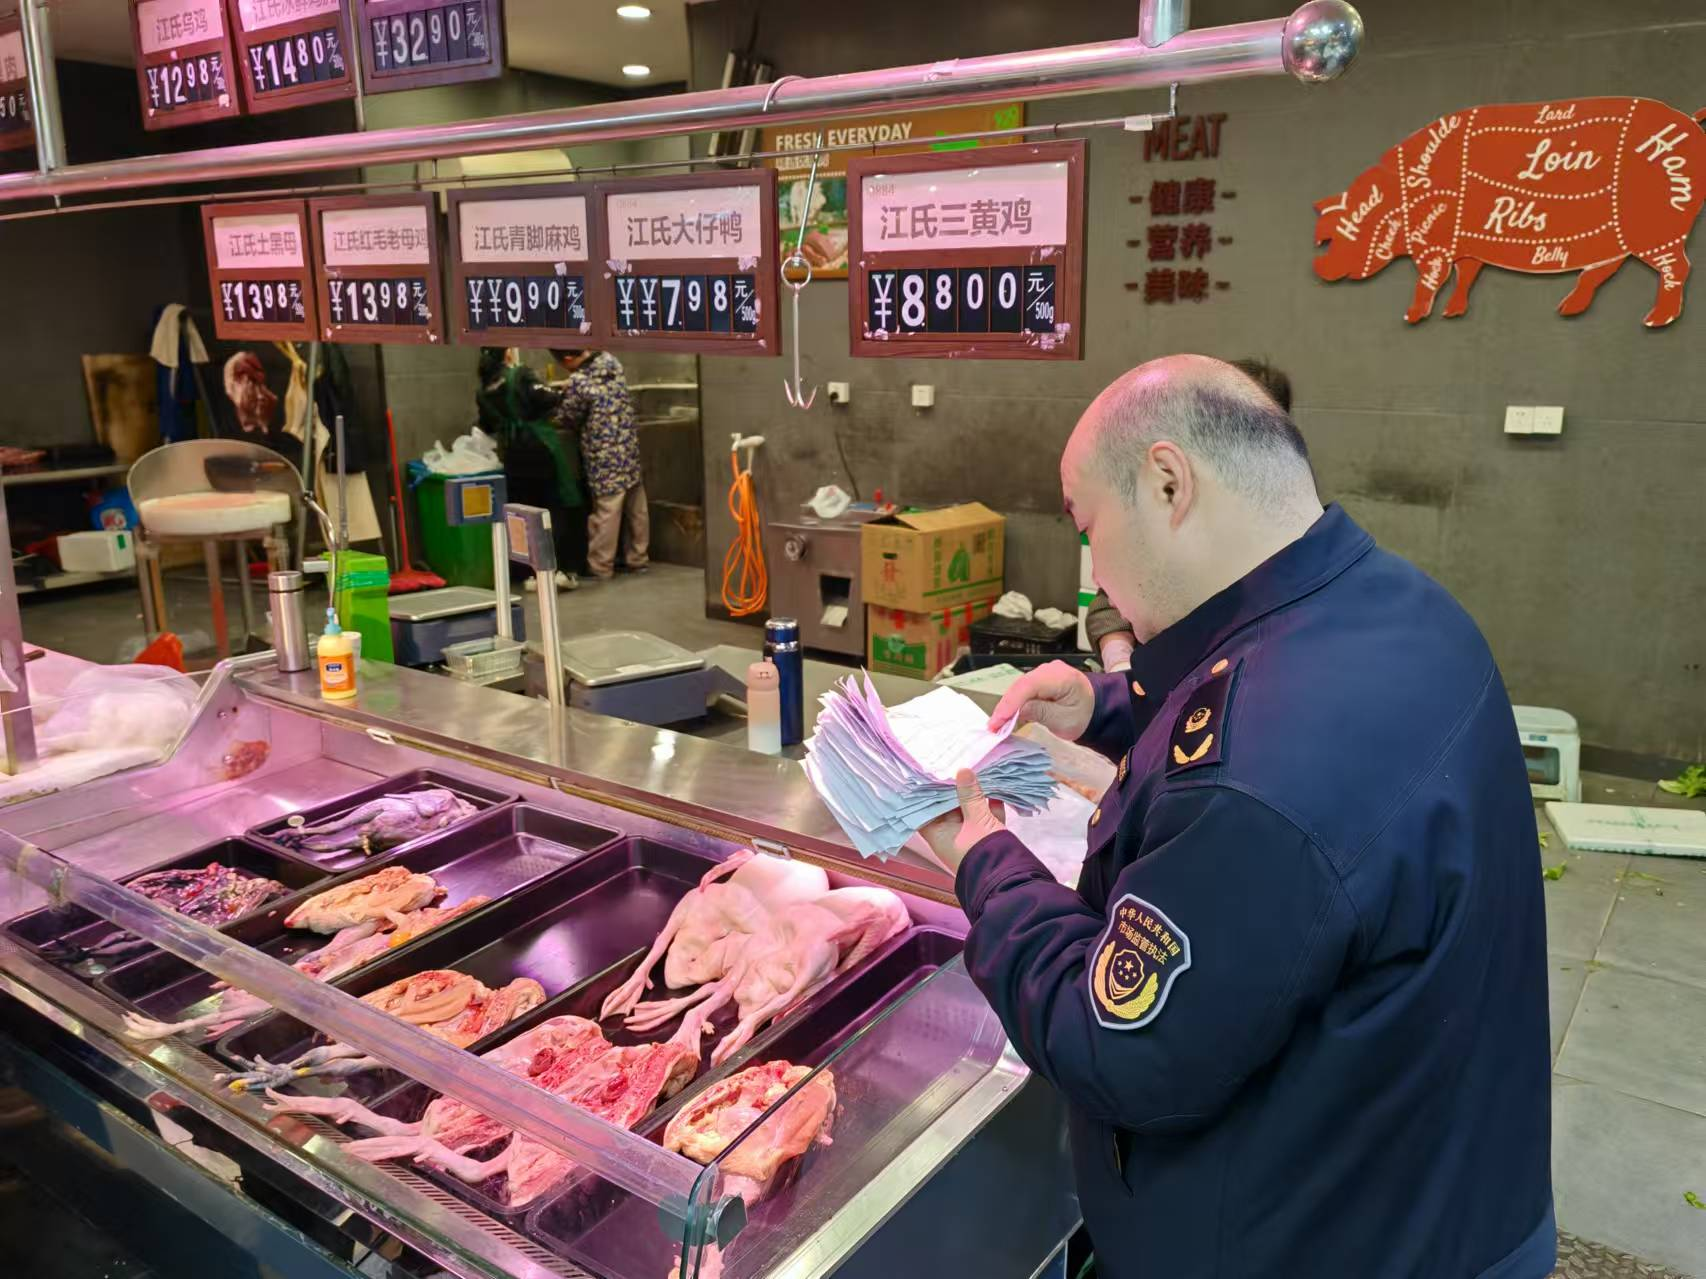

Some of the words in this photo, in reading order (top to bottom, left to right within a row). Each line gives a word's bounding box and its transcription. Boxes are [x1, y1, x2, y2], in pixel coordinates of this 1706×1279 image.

[156, 8, 209, 44] 江氏乌鸡
[827, 121, 913, 147] EVERYDAY
[1534, 104, 1576, 124] Lard
[1143, 112, 1228, 162] MEAT
[1517, 138, 1602, 180] Loin
[1634, 123, 1692, 212] Ham
[627, 211, 743, 247] 江氏大仔鸭
[880, 197, 1032, 241] 江氏三黄鸡
[1336, 184, 1385, 242] Head
[1410, 201, 1448, 246] Picnic
[1484, 196, 1548, 234] Ribs
[474, 224, 581, 251] 江氏青脚麻鸡
[1147, 221, 1212, 261] 营养
[1375, 213, 1402, 260] Cheek
[1531, 245, 1569, 268] Belly
[1652, 252, 1682, 292] Hock
[1118, 920, 1168, 966] 市场监管执法
[1119, 906, 1180, 957] 中华人民共和国
